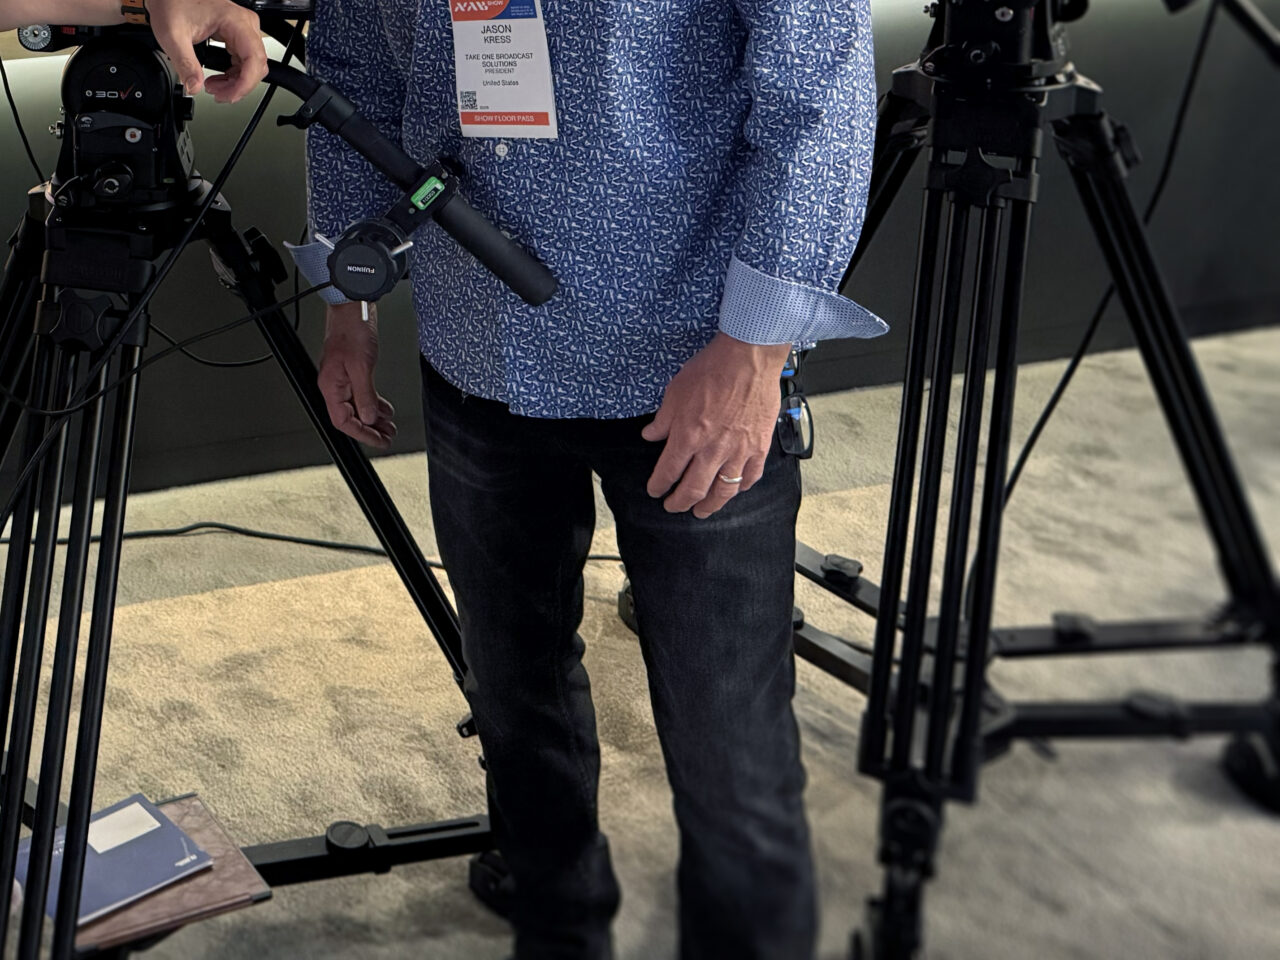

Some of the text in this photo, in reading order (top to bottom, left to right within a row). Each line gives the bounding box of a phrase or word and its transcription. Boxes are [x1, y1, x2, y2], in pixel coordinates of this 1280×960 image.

[481, 24, 512, 34] JASON
[484, 35, 511, 44] KRESS
[496, 52, 533, 60] BROADCAST
[347, 265, 375, 274] FUJINON
